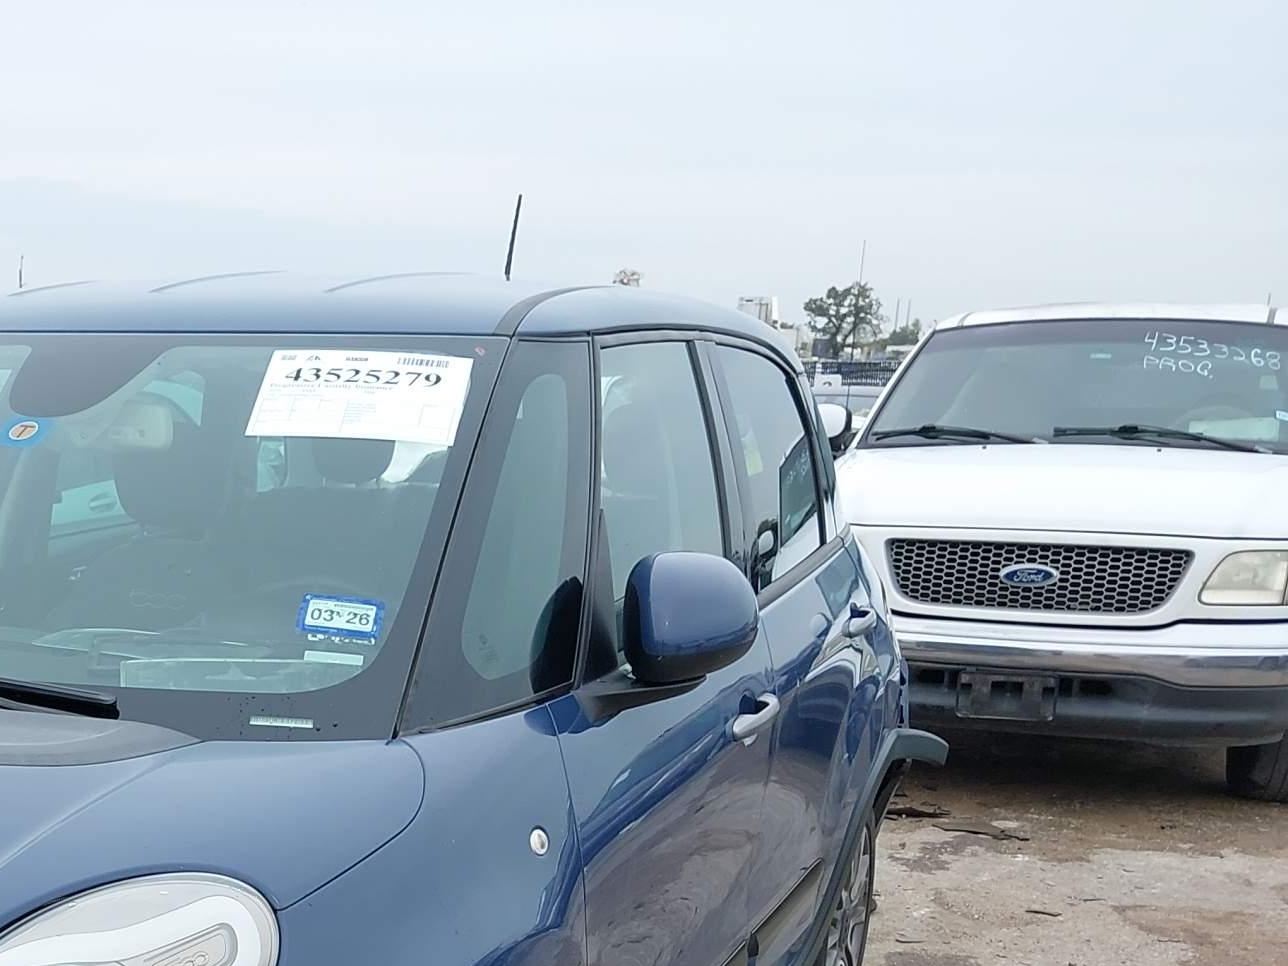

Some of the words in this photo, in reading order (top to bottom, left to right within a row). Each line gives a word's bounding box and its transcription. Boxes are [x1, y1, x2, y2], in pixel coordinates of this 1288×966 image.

[1143, 331, 1282, 371] 43533268
[284, 367, 443, 388] 43525279
[1013, 569, 1045, 582] Ford
[311, 607, 334, 622] 03
[345, 611, 371, 626] 26
